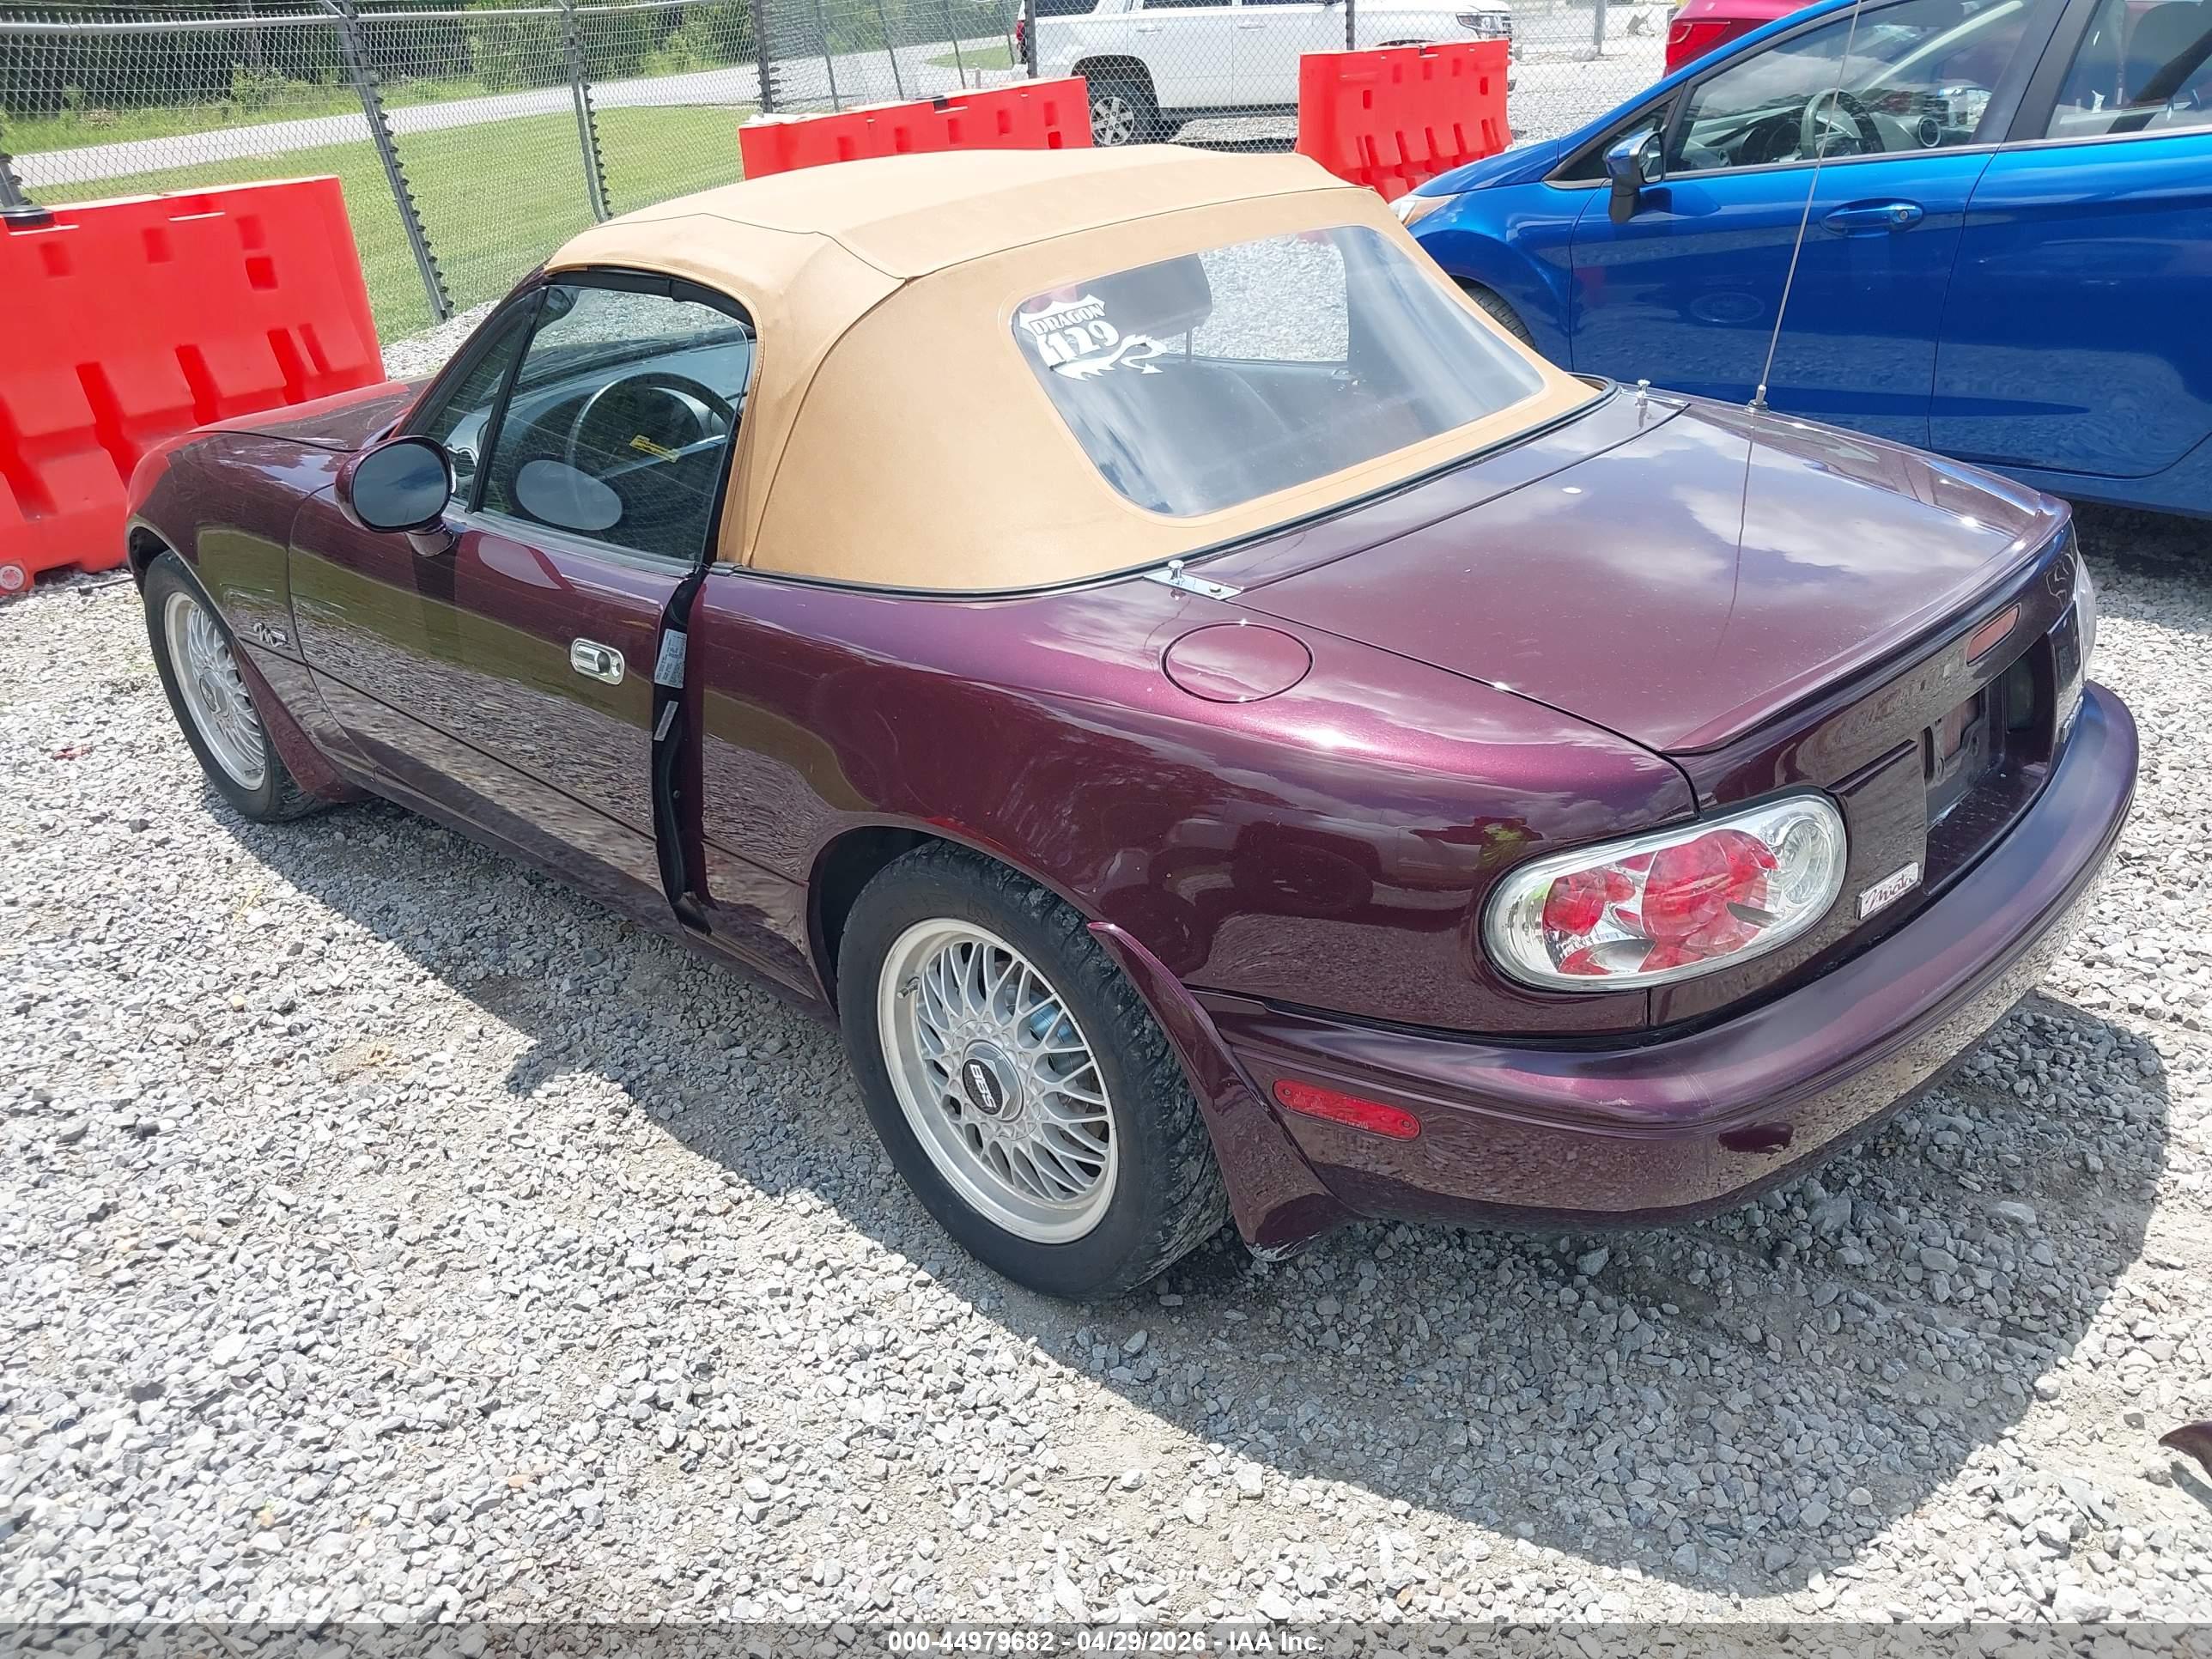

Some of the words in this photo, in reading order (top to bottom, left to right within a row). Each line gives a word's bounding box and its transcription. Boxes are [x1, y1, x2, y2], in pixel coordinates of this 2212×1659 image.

[1030, 303, 1106, 335] DRAGON
[1047, 320, 1120, 362] 129
[1865, 872, 1914, 911] Miata
[969, 1063, 997, 1108] BBS
